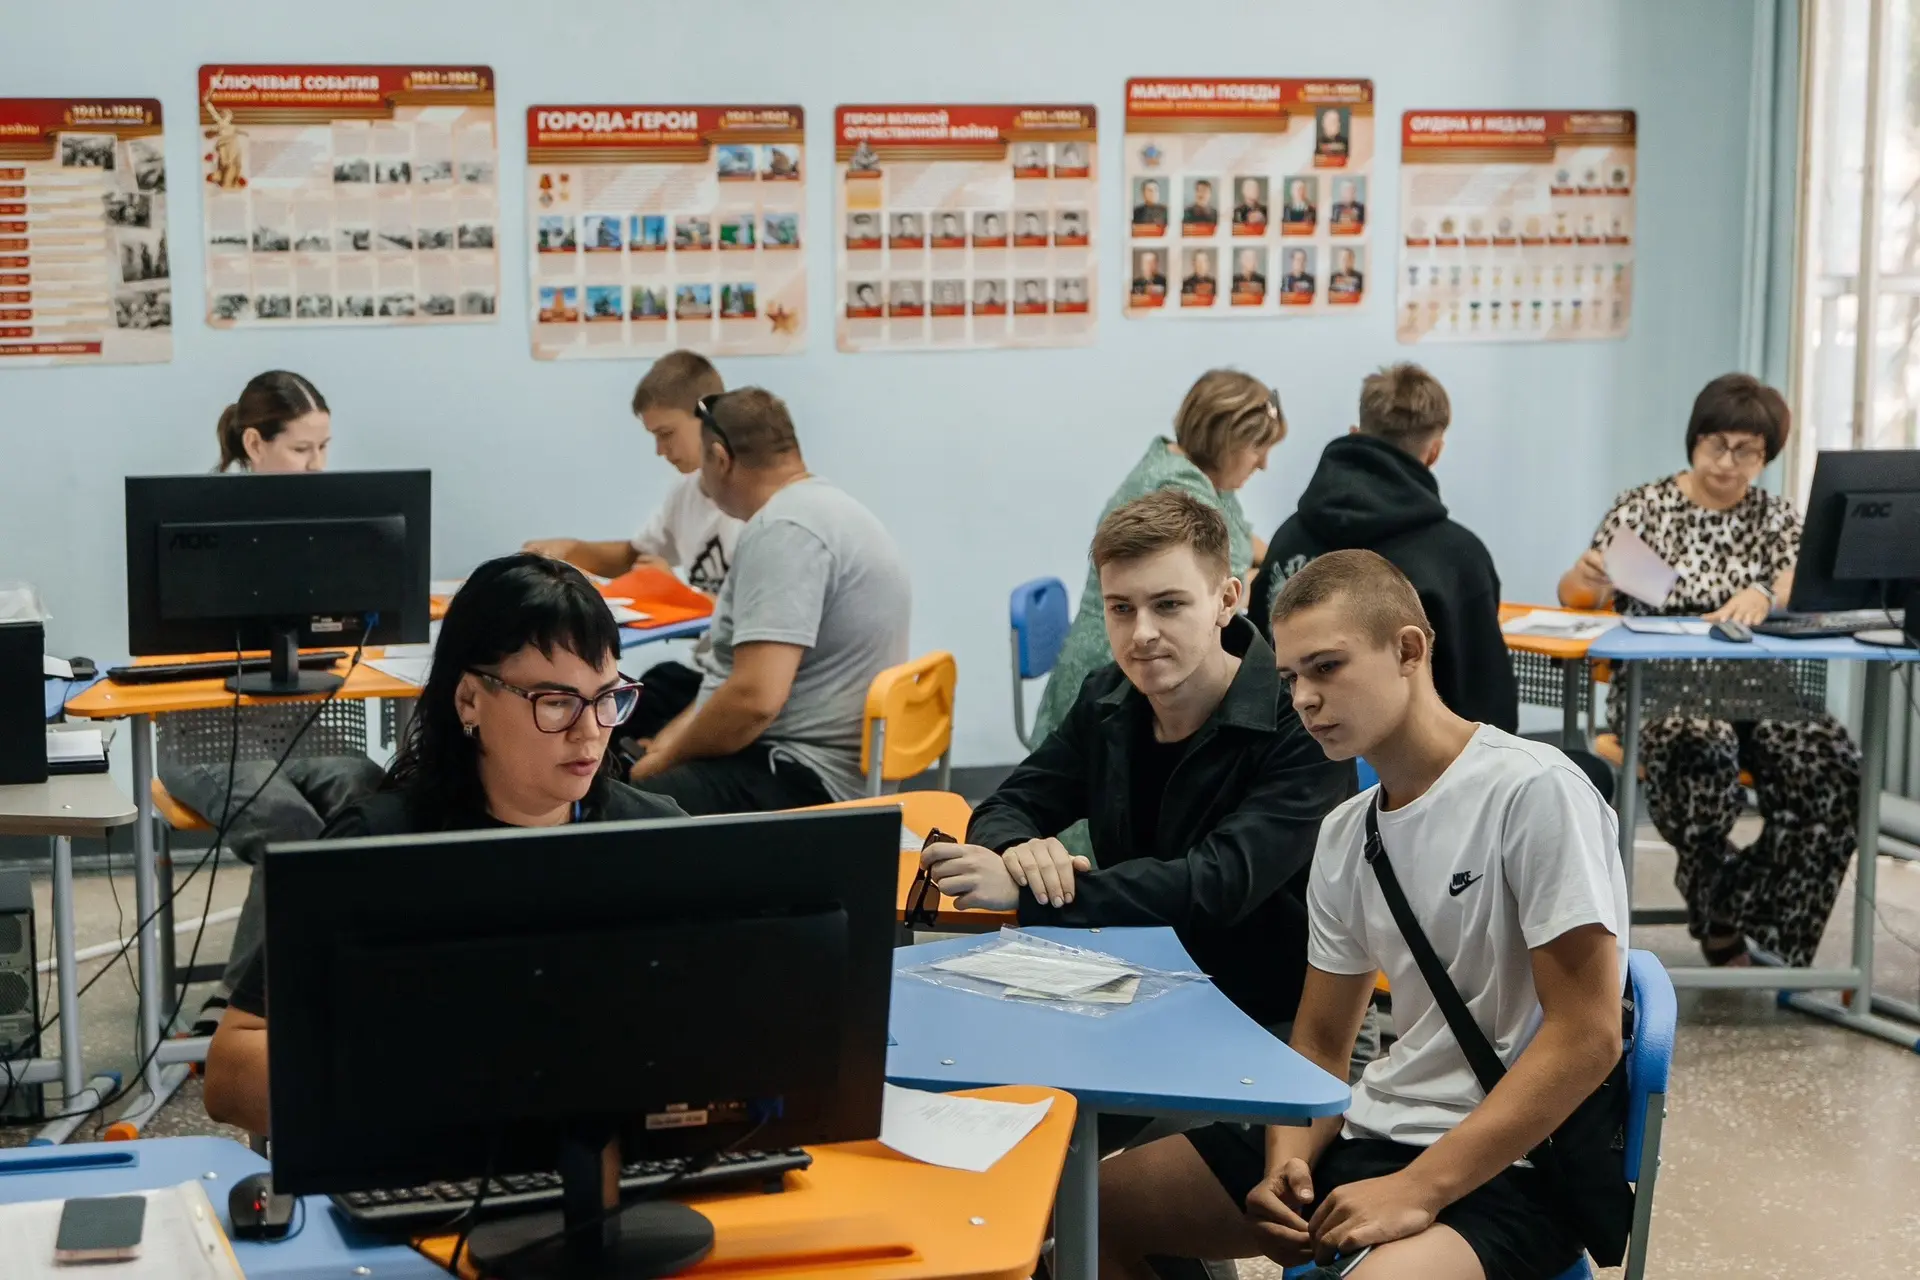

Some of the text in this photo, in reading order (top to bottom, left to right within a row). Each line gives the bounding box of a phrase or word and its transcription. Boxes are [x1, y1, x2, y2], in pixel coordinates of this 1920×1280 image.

[210, 75, 380, 90] КЛЮЧЕВЫЕ СОБЫТИЯ
[1131, 84, 1280, 102] МАРШАЛЫ ПОБЕДЫ
[537, 111, 698, 132] ГОРОДА-ГЕРОИ
[1852, 502, 1893, 518] AOC
